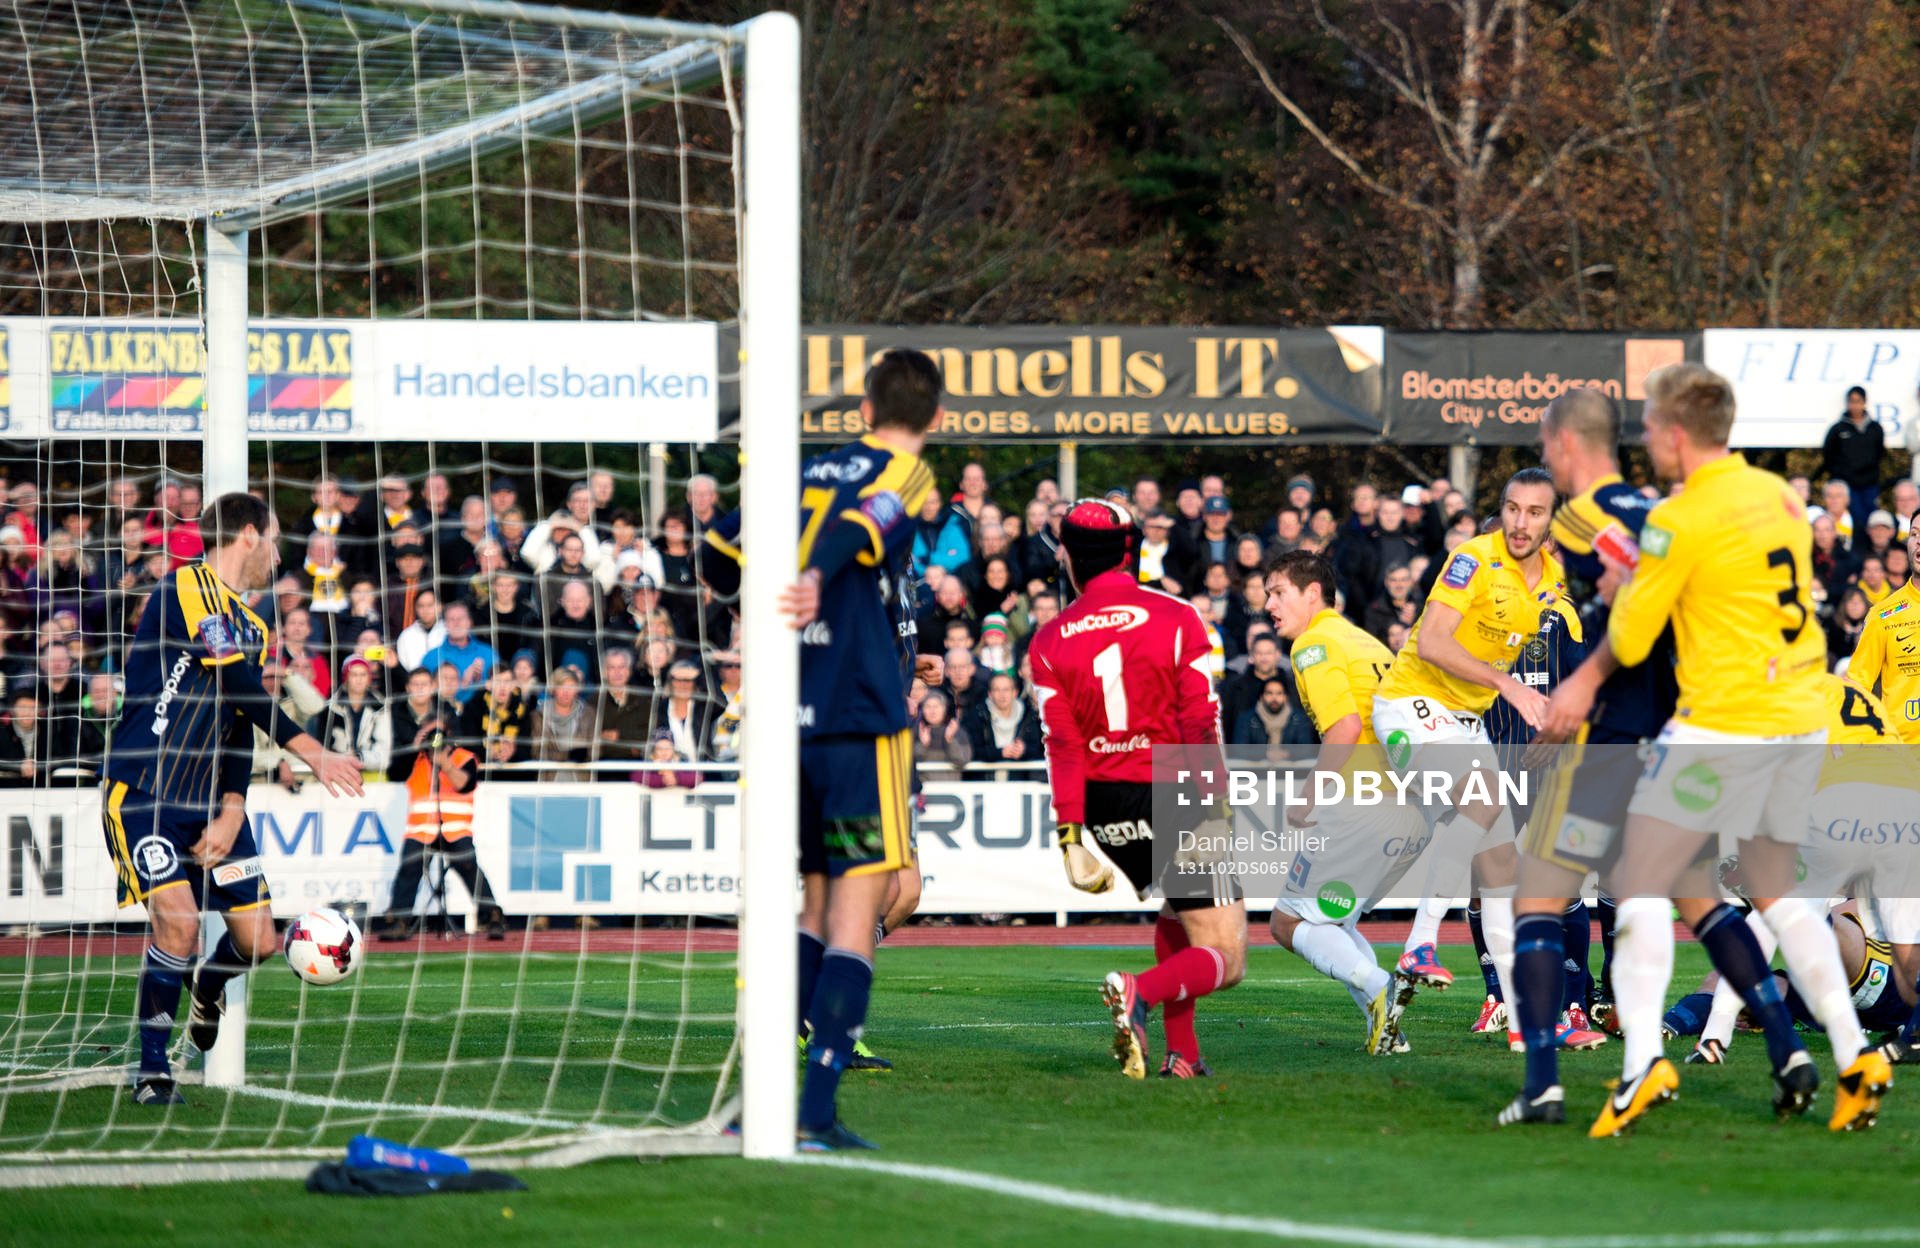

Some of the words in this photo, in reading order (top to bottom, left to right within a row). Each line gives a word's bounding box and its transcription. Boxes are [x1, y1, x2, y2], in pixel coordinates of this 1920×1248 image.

[50, 331, 282, 373] FALKENBGS
[287, 333, 350, 374] LAX
[802, 334, 1166, 399] Hnnells
[1194, 337, 1299, 399] IT.
[1738, 341, 1918, 382] FILP
[393, 363, 709, 398] Handelsbanken
[802, 410, 873, 433] LES
[1054, 410, 1151, 434] MORE
[1162, 411, 1299, 435] VALUES.
[1440, 401, 1484, 428] City
[1766, 546, 1807, 644] 3
[1093, 642, 1128, 732] 1
[1413, 699, 1430, 719] 8
[1840, 685, 1885, 737] 4
[1320, 889, 1352, 910] dina
